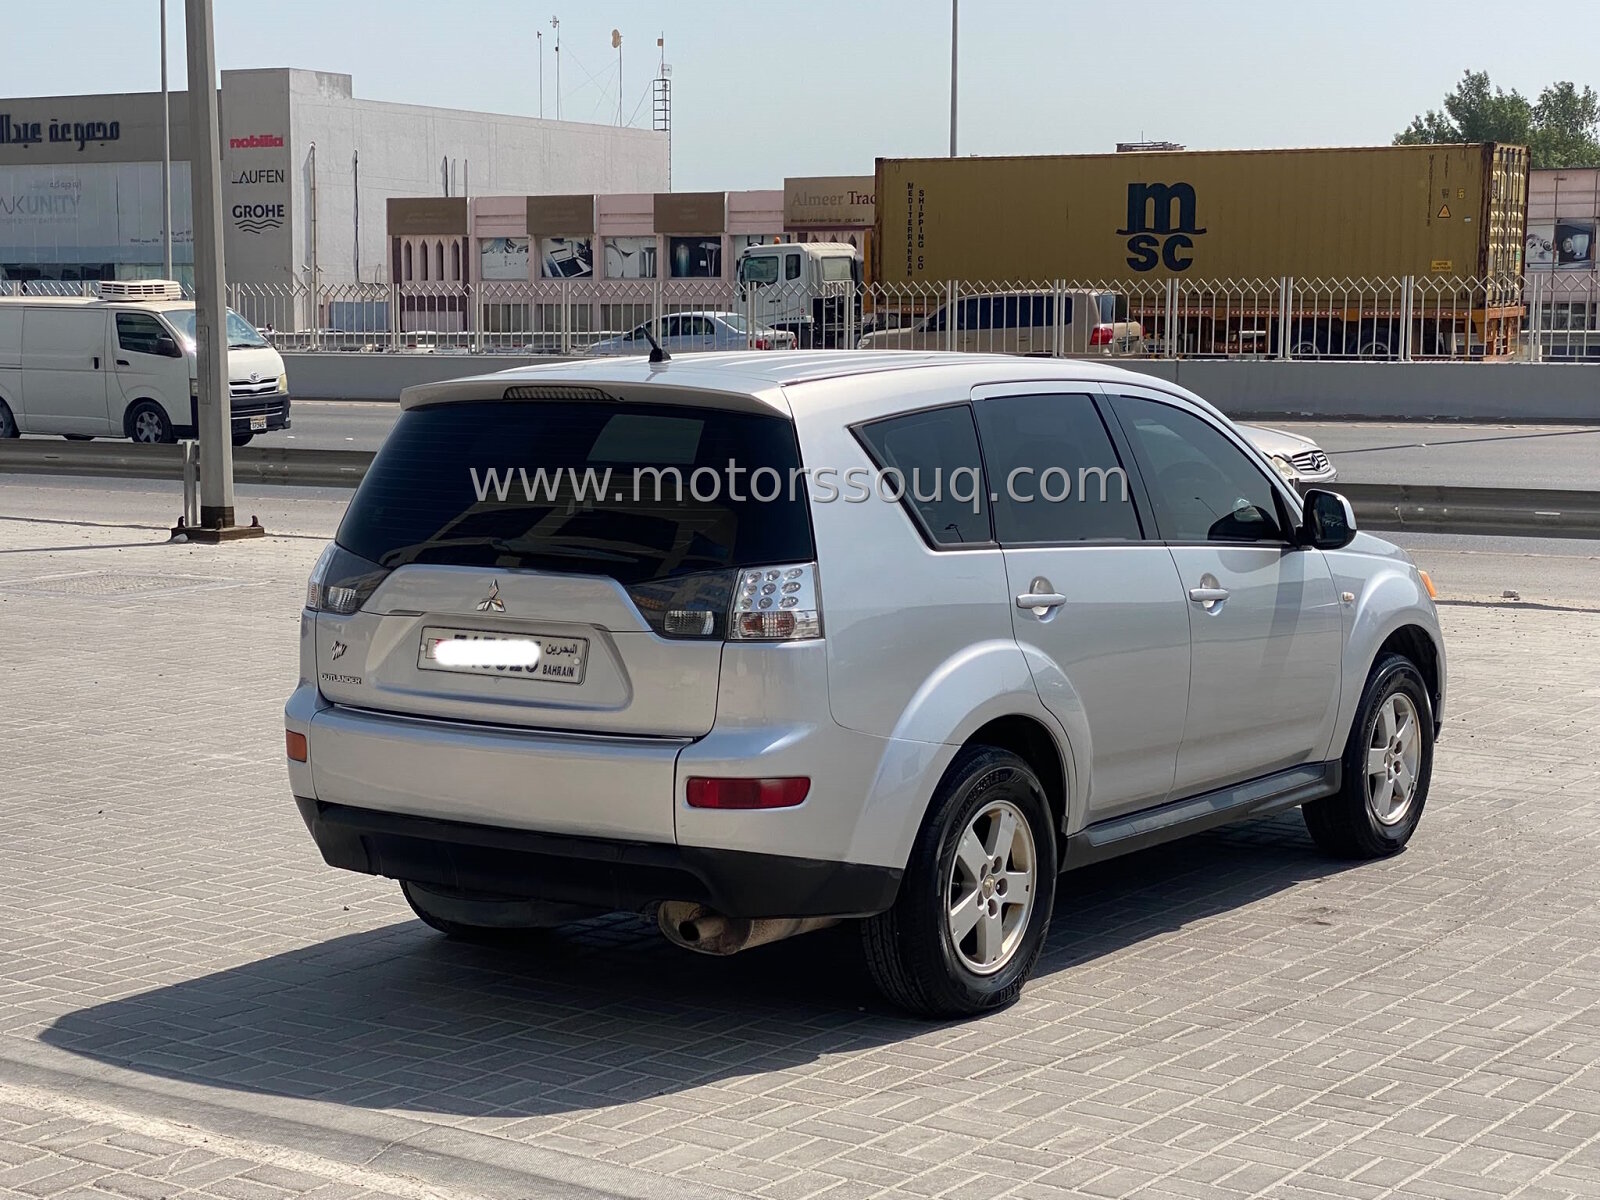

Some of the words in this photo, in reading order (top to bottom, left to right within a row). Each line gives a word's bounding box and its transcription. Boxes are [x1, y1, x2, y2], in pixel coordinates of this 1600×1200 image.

[48, 118, 120, 152] مجموعة
[229, 135, 284, 149] nobilia
[231, 169, 284, 184] LAUFEN
[791, 191, 844, 207] Almeer
[232, 204, 285, 218] GROHE
[918, 255, 925, 270] CO
[545, 643, 578, 657] البحرين
[542, 664, 575, 677] BAHRAIN
[320, 672, 362, 684] OUTLANDER
